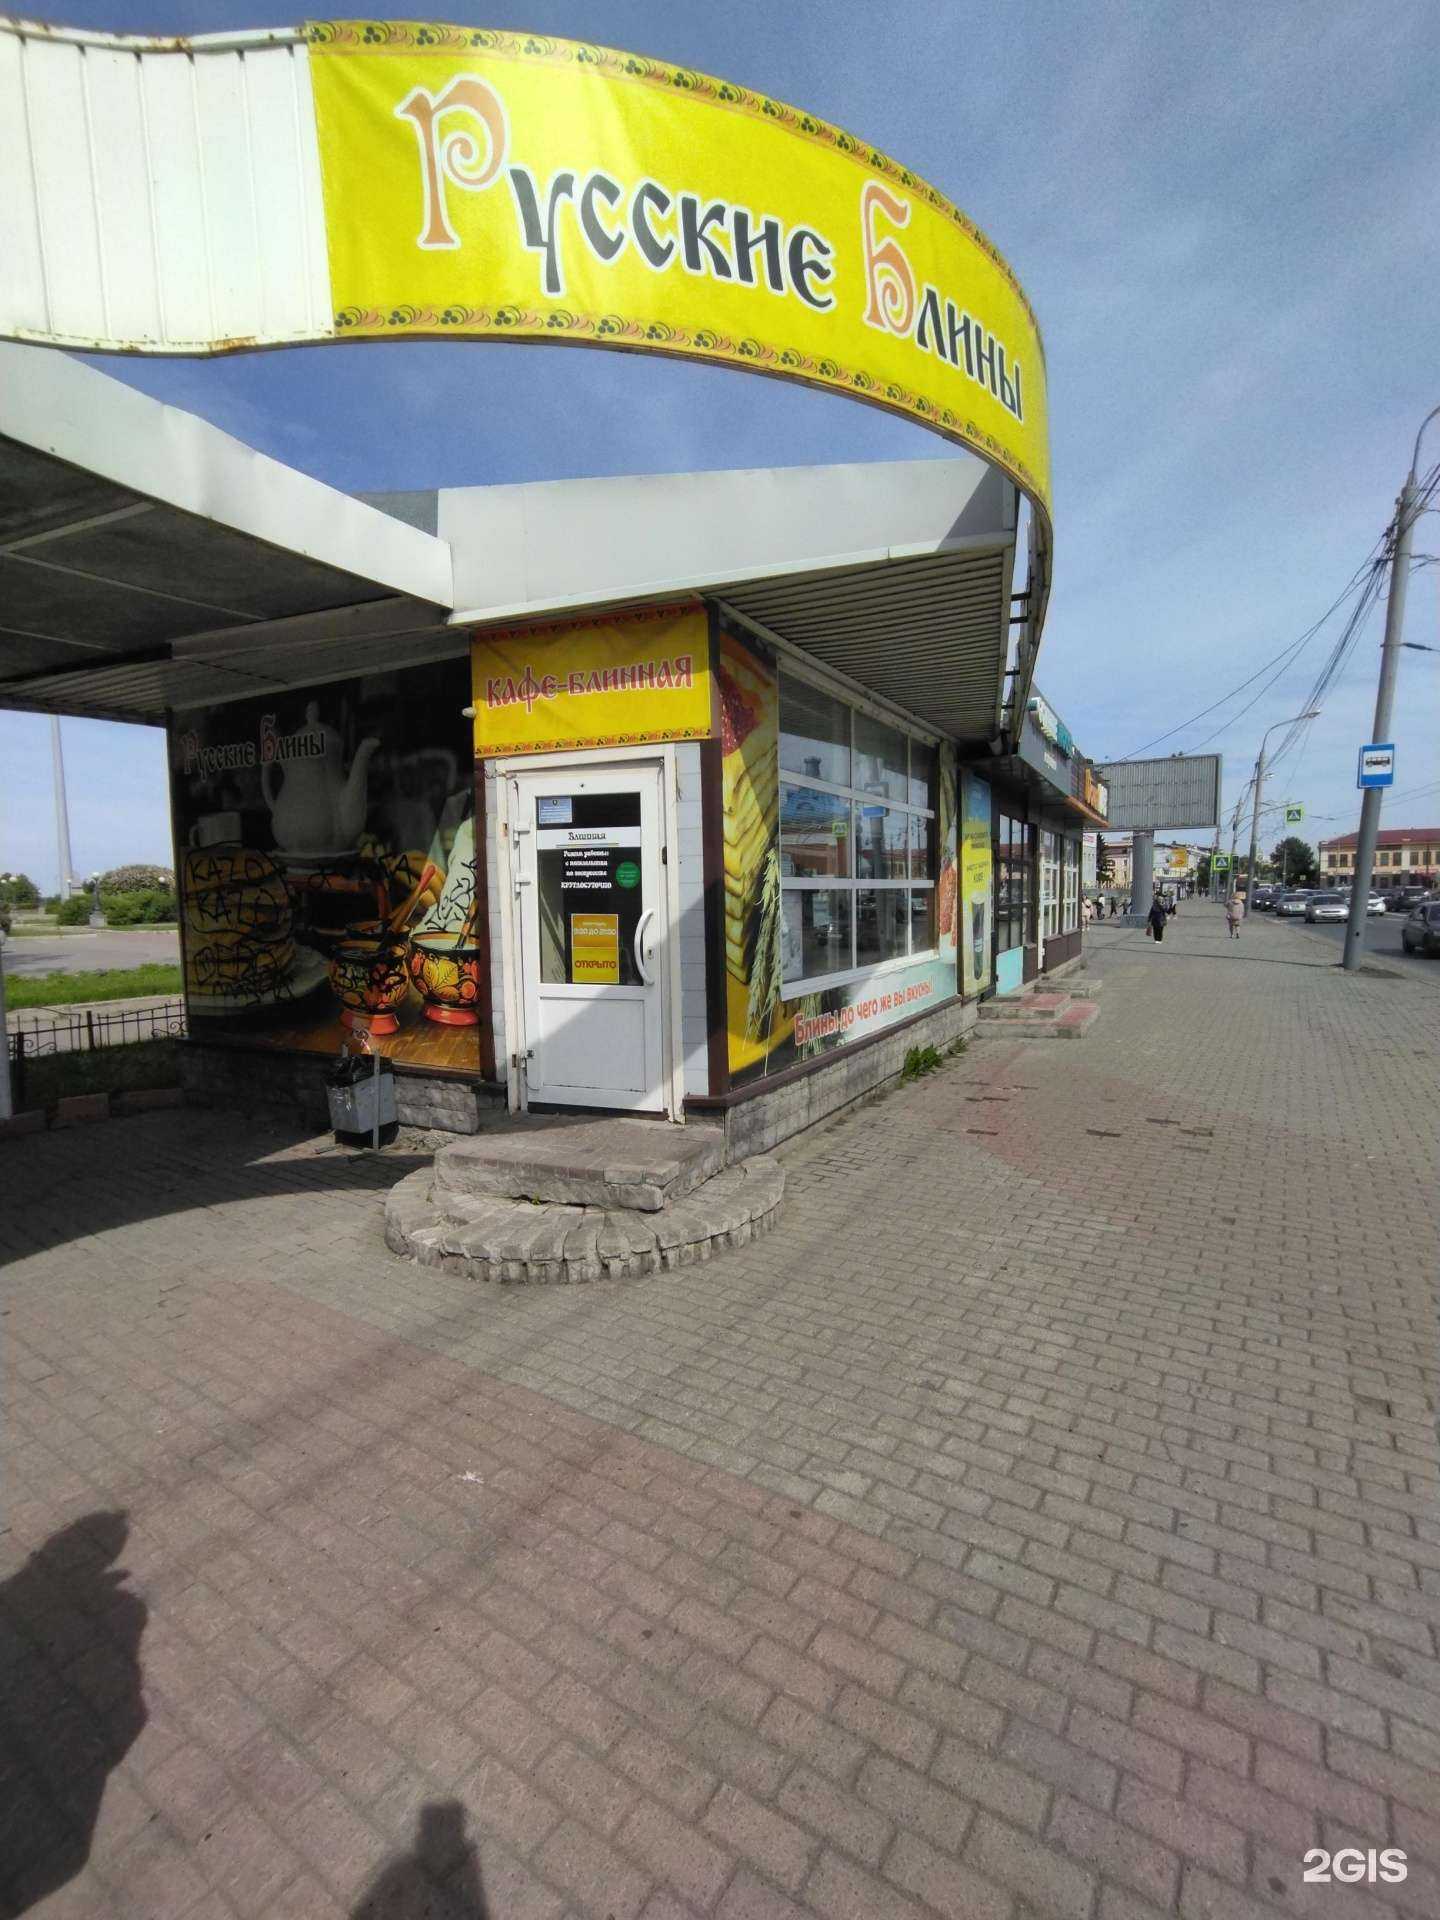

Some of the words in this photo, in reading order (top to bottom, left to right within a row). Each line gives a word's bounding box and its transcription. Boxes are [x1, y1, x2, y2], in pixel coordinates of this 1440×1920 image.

[574, 959, 617, 970] ОТКРЫТО
[793, 1012, 839, 1047] Блины
[839, 1005, 855, 1033] до
[857, 998, 878, 1020] чего
[880, 994, 892, 1013] же
[893, 990, 905, 1008] вы
